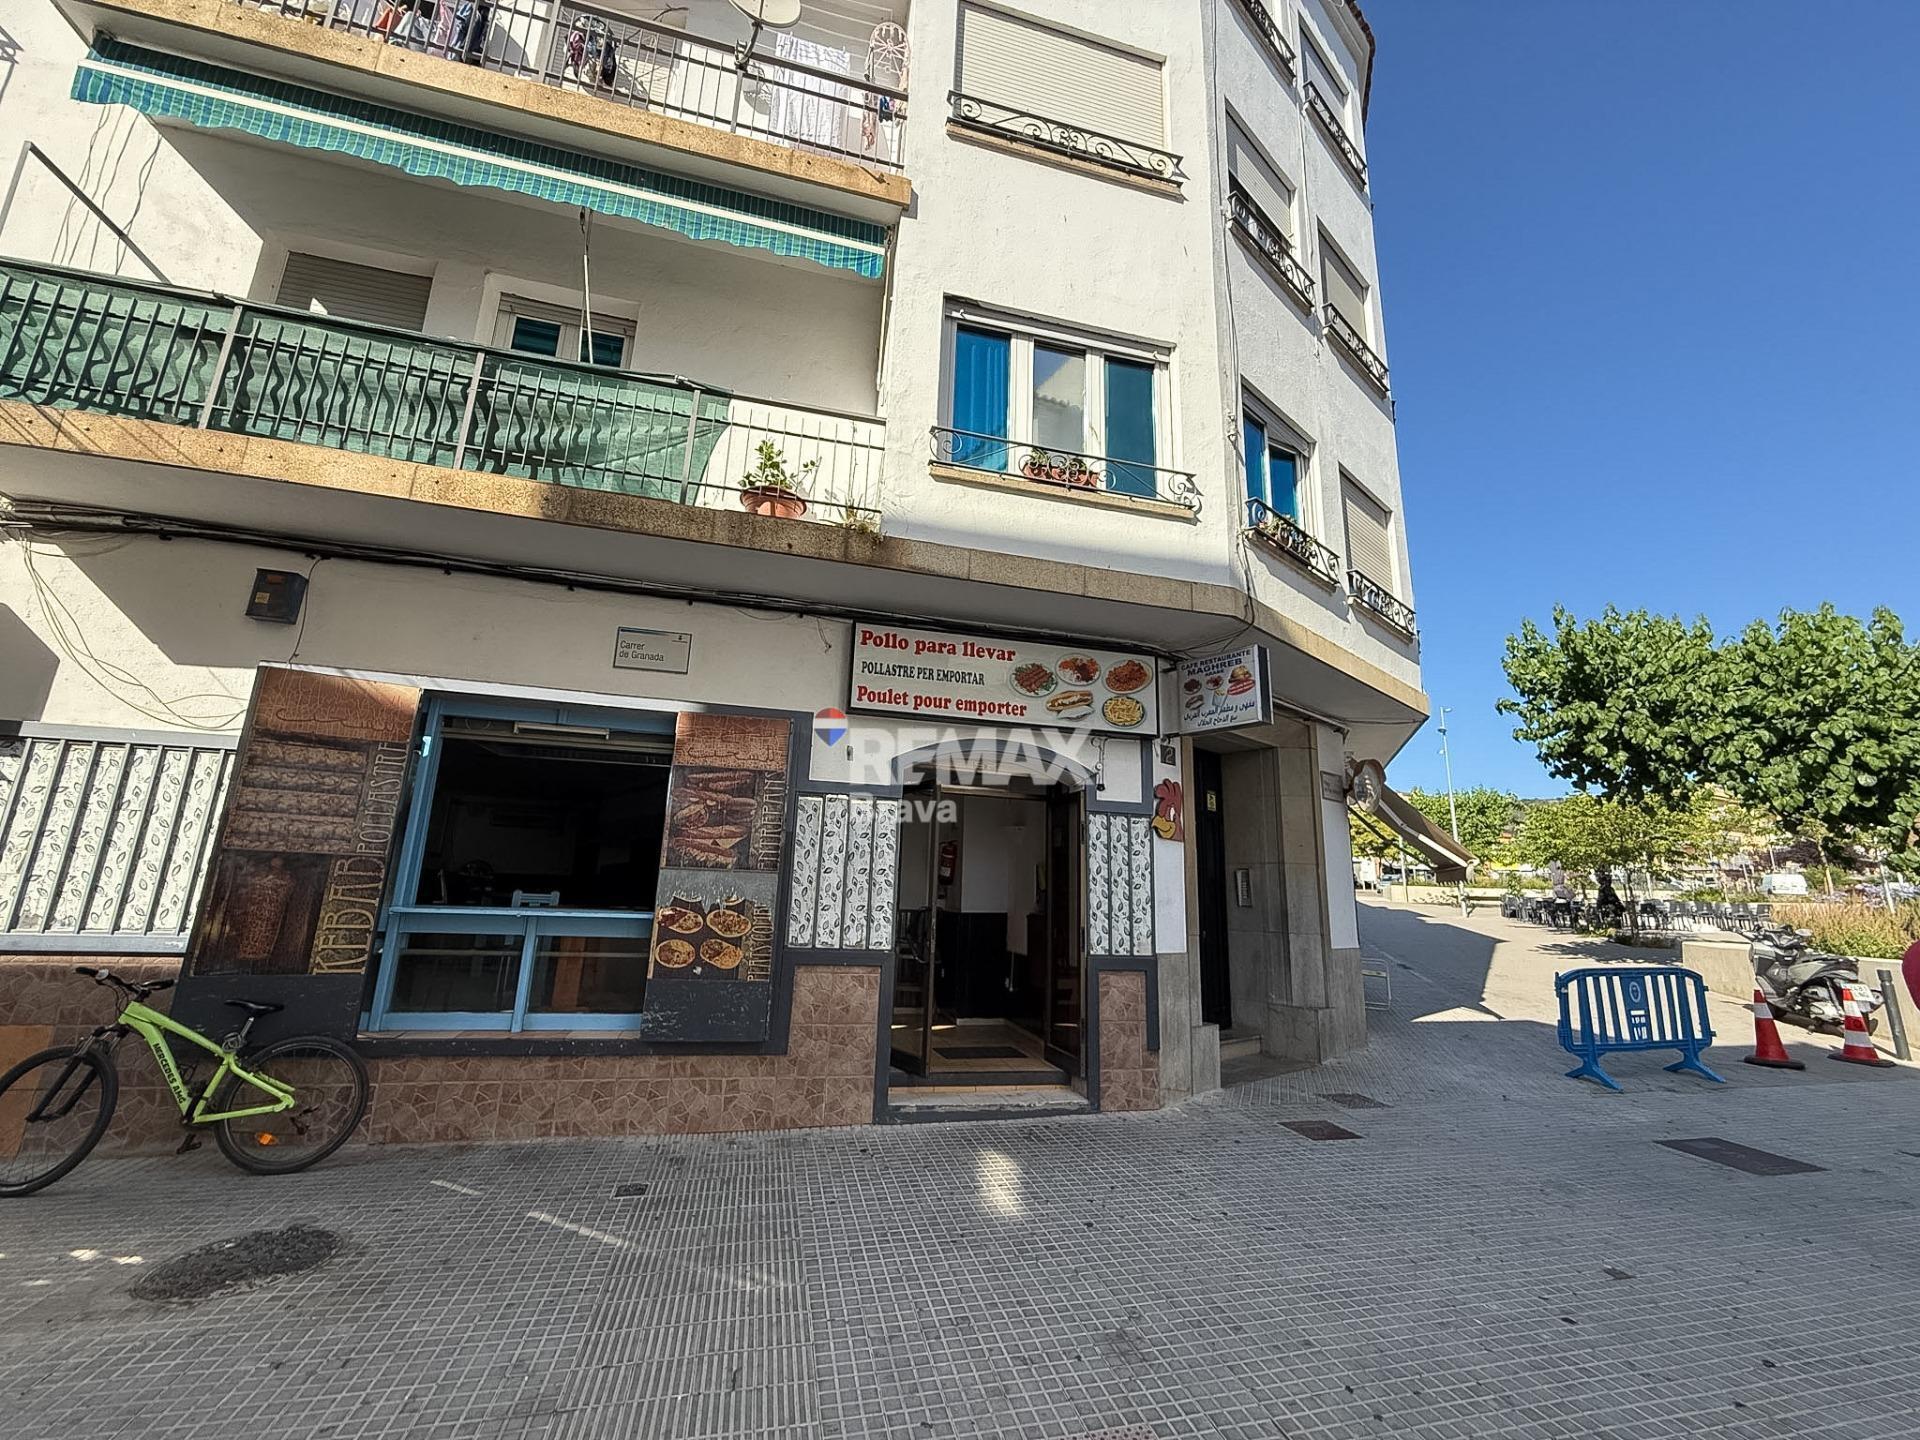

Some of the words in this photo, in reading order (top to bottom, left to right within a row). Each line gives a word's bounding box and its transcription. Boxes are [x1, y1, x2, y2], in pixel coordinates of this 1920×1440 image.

[619, 650, 629, 659] de
[631, 650, 665, 662] Granada
[620, 640, 646, 650] Carrer
[860, 629, 909, 650] Pollo
[914, 639, 957, 656] para
[962, 641, 1017, 662] llevar
[1199, 650, 1251, 667] RESTAURANTE
[861, 660, 916, 679] POLLASTRE
[916, 666, 935, 681] PER
[936, 669, 985, 686] EMPORTAR
[1187, 658, 1243, 676] MAGHREB
[856, 685, 909, 706] Poulet
[913, 694, 952, 710] pour
[955, 698, 1027, 717] emporter
[356, 741, 409, 855] POLLASTRE
[757, 771, 786, 872] ENTREPANS
[313, 856, 387, 977] KEBAB
[153, 1043, 177, 1084] MERCEDES
[173, 1086, 187, 1104] AMG
